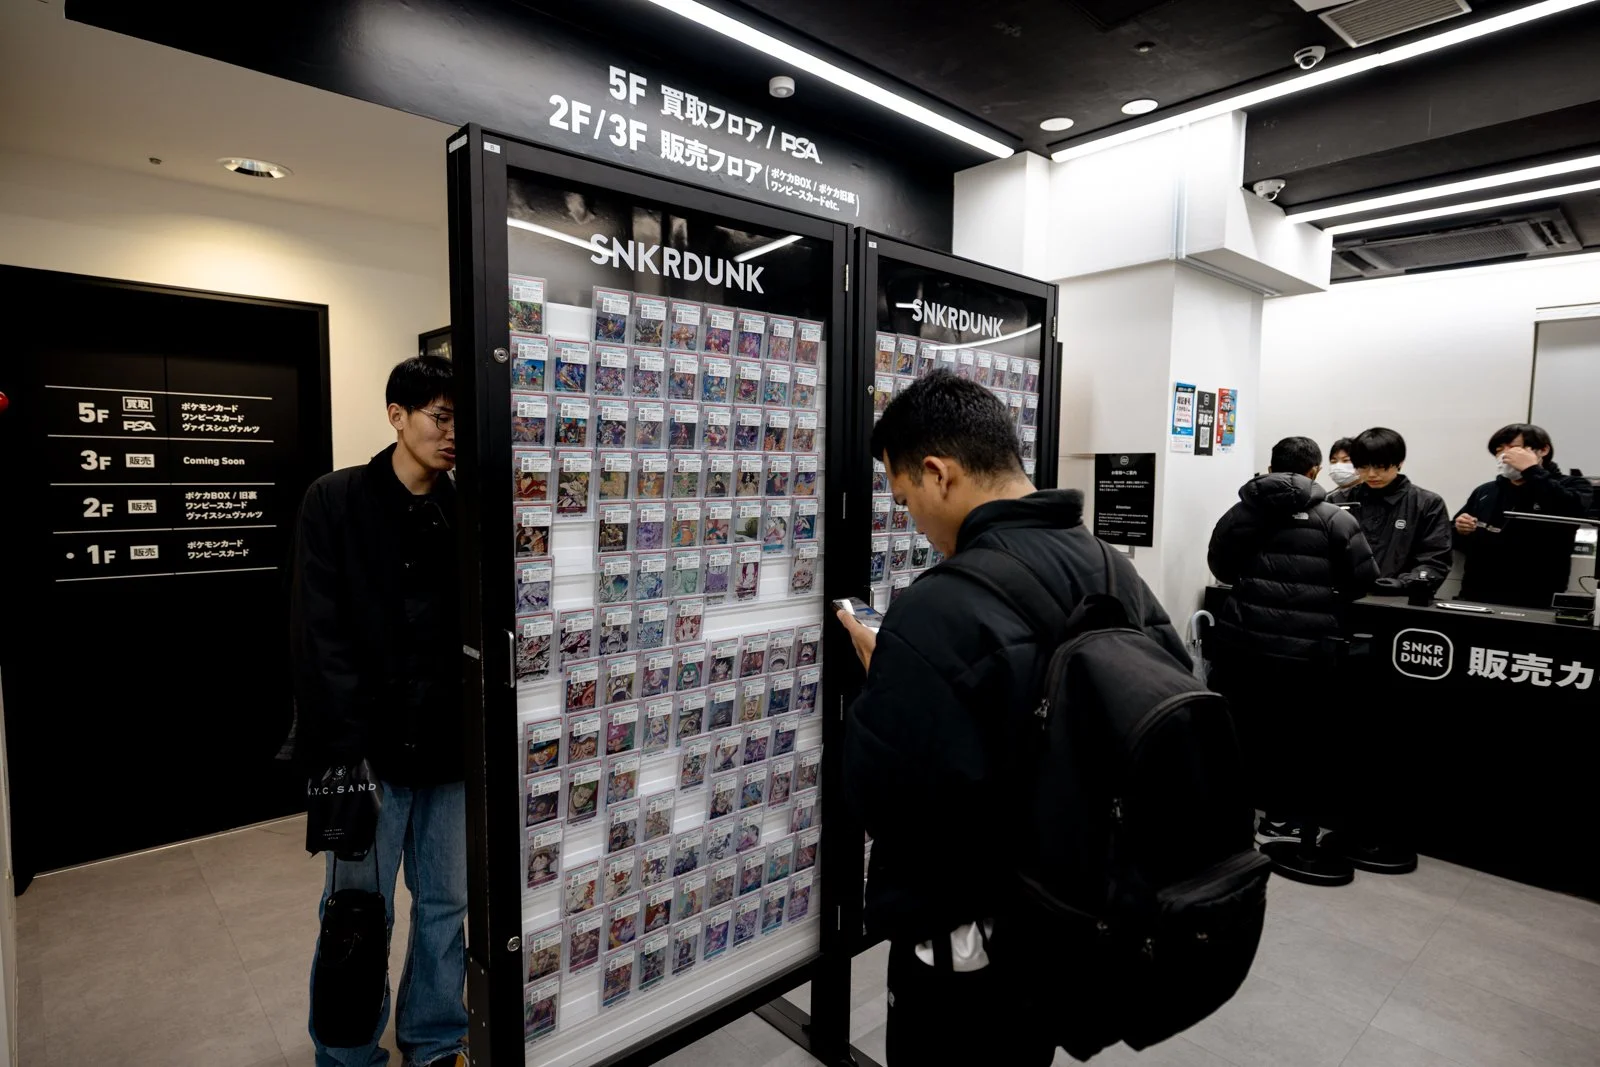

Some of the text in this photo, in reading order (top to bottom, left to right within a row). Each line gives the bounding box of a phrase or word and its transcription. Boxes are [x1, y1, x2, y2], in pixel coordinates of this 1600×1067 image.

[609, 65, 648, 106] 5F
[660, 84, 764, 143] 買取フロア
[781, 131, 823, 165] PSA
[660, 129, 763, 184] 販売フロア
[590, 233, 765, 295] SNKRDUNK
[911, 298, 1004, 338] SNKRDUNK
[78, 399, 150, 423] 5F 買取
[181, 402, 239, 413] ポケモンカード
[123, 420, 156, 432] PSA
[181, 412, 245, 423] ワンピースカード
[181, 423, 260, 434] ヴァイスシュヴァルツ
[80, 449, 246, 471] 3F 販売 Coming Soon
[185, 491, 231, 500] ポケカBOX
[239, 491, 258, 500] 旧裏
[82, 497, 248, 518] 2F 販売 ワンピースカード
[185, 511, 263, 521] ヴァイスシュヴァルツ
[86, 540, 244, 565] 1F 販売 ポケモンカード
[187, 549, 249, 560] ワンピースカード
[1402, 640, 1444, 656] SNKR
[1400, 652, 1444, 668] DUNK
[1467, 647, 1600, 690] 販売カ
